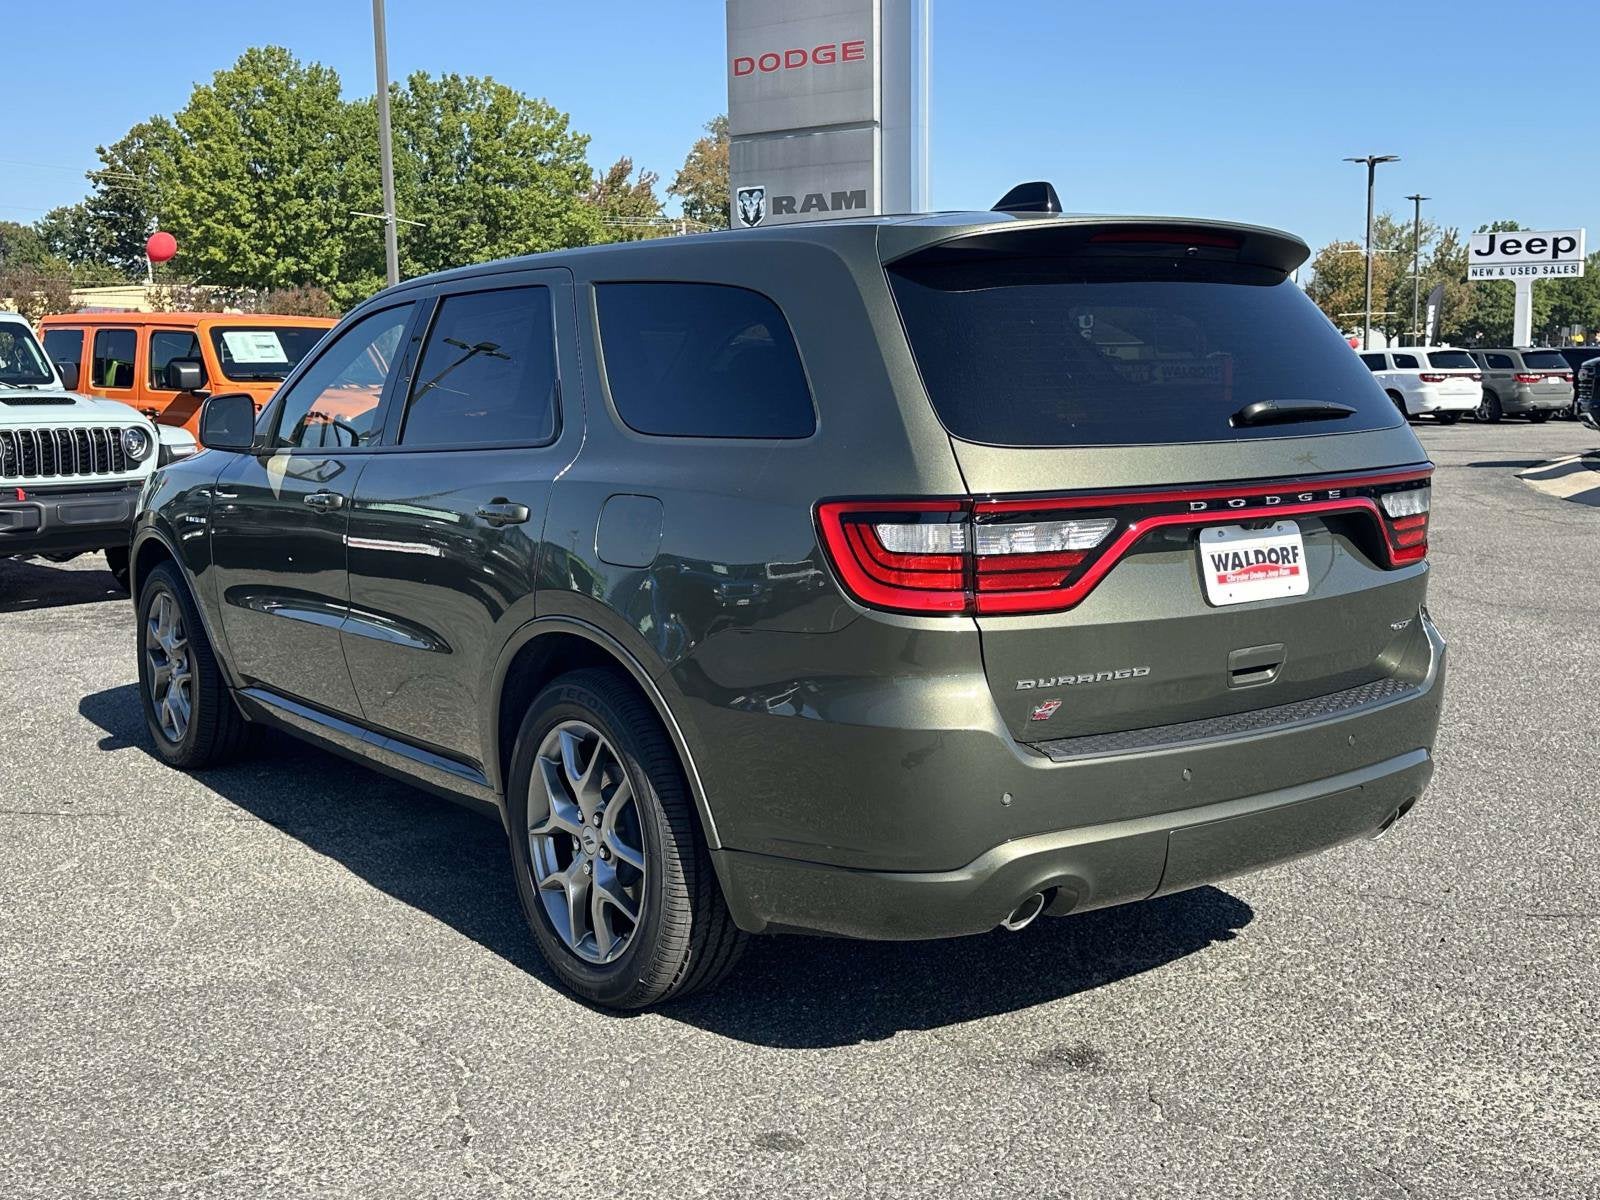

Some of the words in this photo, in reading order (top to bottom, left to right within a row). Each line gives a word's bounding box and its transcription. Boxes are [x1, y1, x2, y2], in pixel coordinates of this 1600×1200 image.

[733, 40, 865, 77] DODGE
[772, 189, 867, 216] RAM
[1474, 233, 1577, 260] Jeep
[1471, 267, 1494, 277] NEW
[1498, 267, 1505, 276] &
[1510, 266, 1538, 276] USED
[1542, 264, 1577, 275] SALES
[1189, 489, 1342, 512] DODGE
[1210, 545, 1299, 572] WALDORF
[1015, 665, 1151, 690] DURANGO
